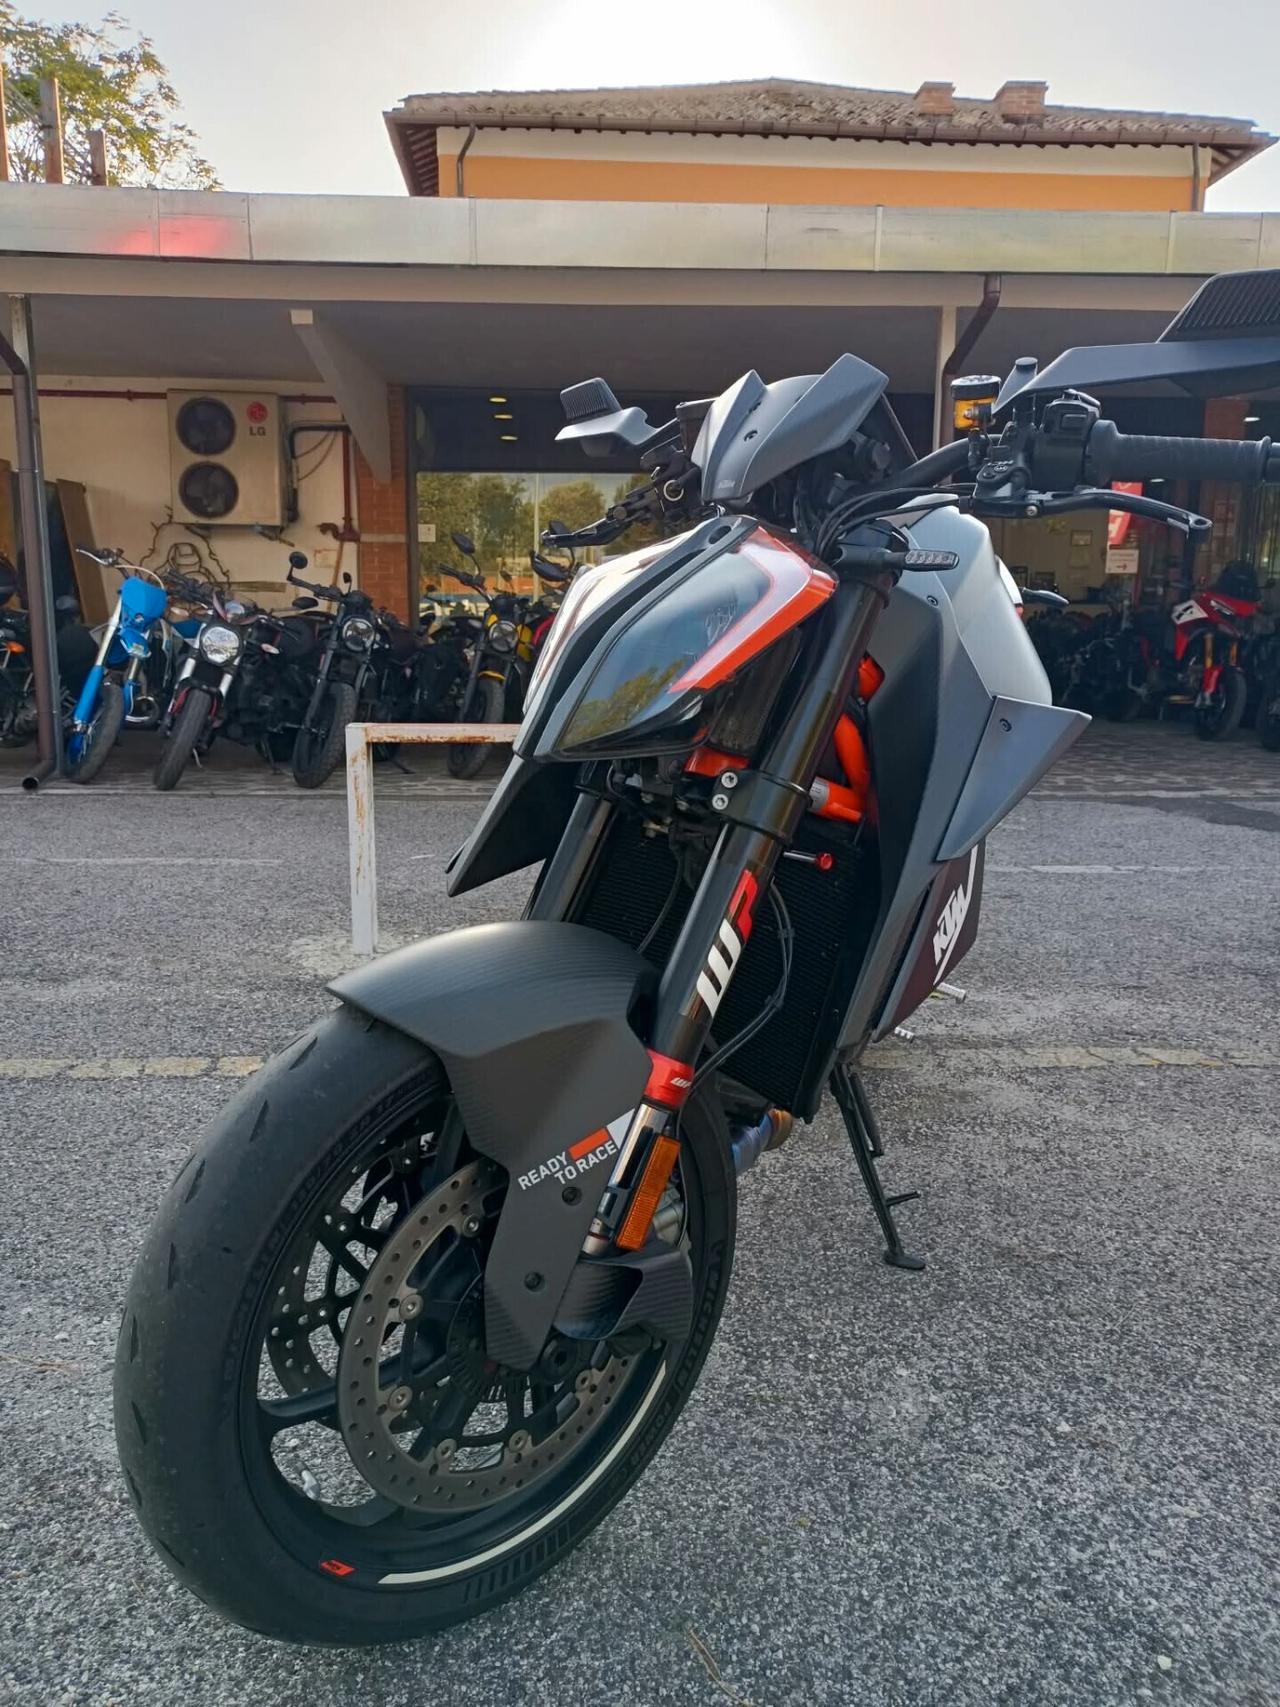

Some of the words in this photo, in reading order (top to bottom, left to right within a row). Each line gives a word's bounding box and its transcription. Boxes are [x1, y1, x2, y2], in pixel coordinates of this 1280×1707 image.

[249, 426, 266, 437] LG
[933, 884, 967, 966] KTM
[518, 1151, 568, 1191] READY
[554, 1164, 577, 1185] TO
[575, 1140, 618, 1173] RACE
